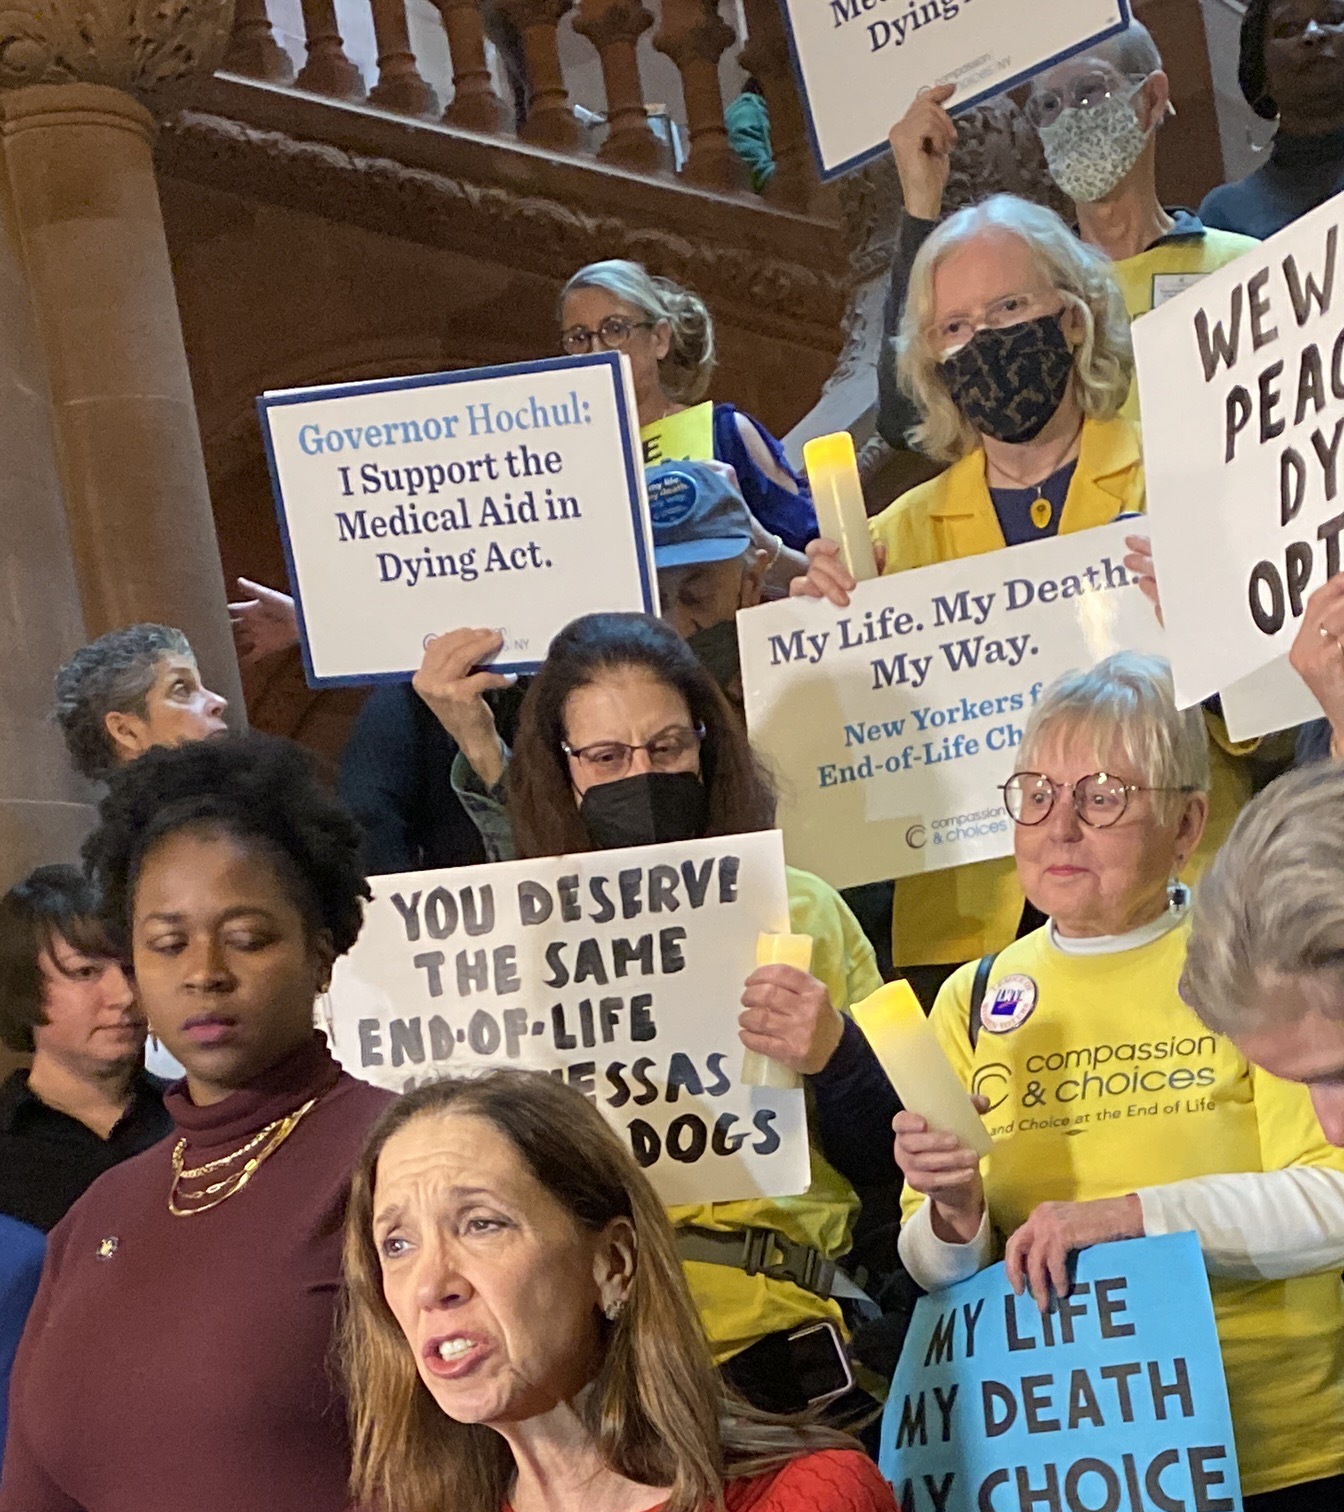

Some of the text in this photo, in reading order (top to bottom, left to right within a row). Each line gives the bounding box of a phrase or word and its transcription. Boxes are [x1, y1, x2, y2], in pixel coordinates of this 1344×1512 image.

[1193, 266, 1280, 383] WE
[298, 391, 592, 456] Governor Hochul:
[338, 444, 563, 497] I Support the
[335, 488, 582, 543] Medical Aid in
[376, 540, 553, 588] Dying Act.
[768, 556, 1141, 666] My Life. My Death.
[870, 633, 1040, 691] My Way.
[844, 716, 906, 748] New
[910, 693, 1025, 732] Yorkers
[816, 729, 981, 788] End-of-Life
[930, 806, 1007, 830] compassion
[932, 819, 1008, 845] & choices
[390, 854, 741, 943] YOU DESERVE
[413, 926, 688, 998] THE SAME
[1025, 1034, 1218, 1074] compassion
[1021, 1064, 1217, 1108] & choices
[627, 1108, 782, 1169] DOGS
[990, 1098, 1217, 1137] and Choice at the End of Life
[923, 1276, 1137, 1368] MY LIFE
[895, 1357, 1195, 1450] MY DEATH
